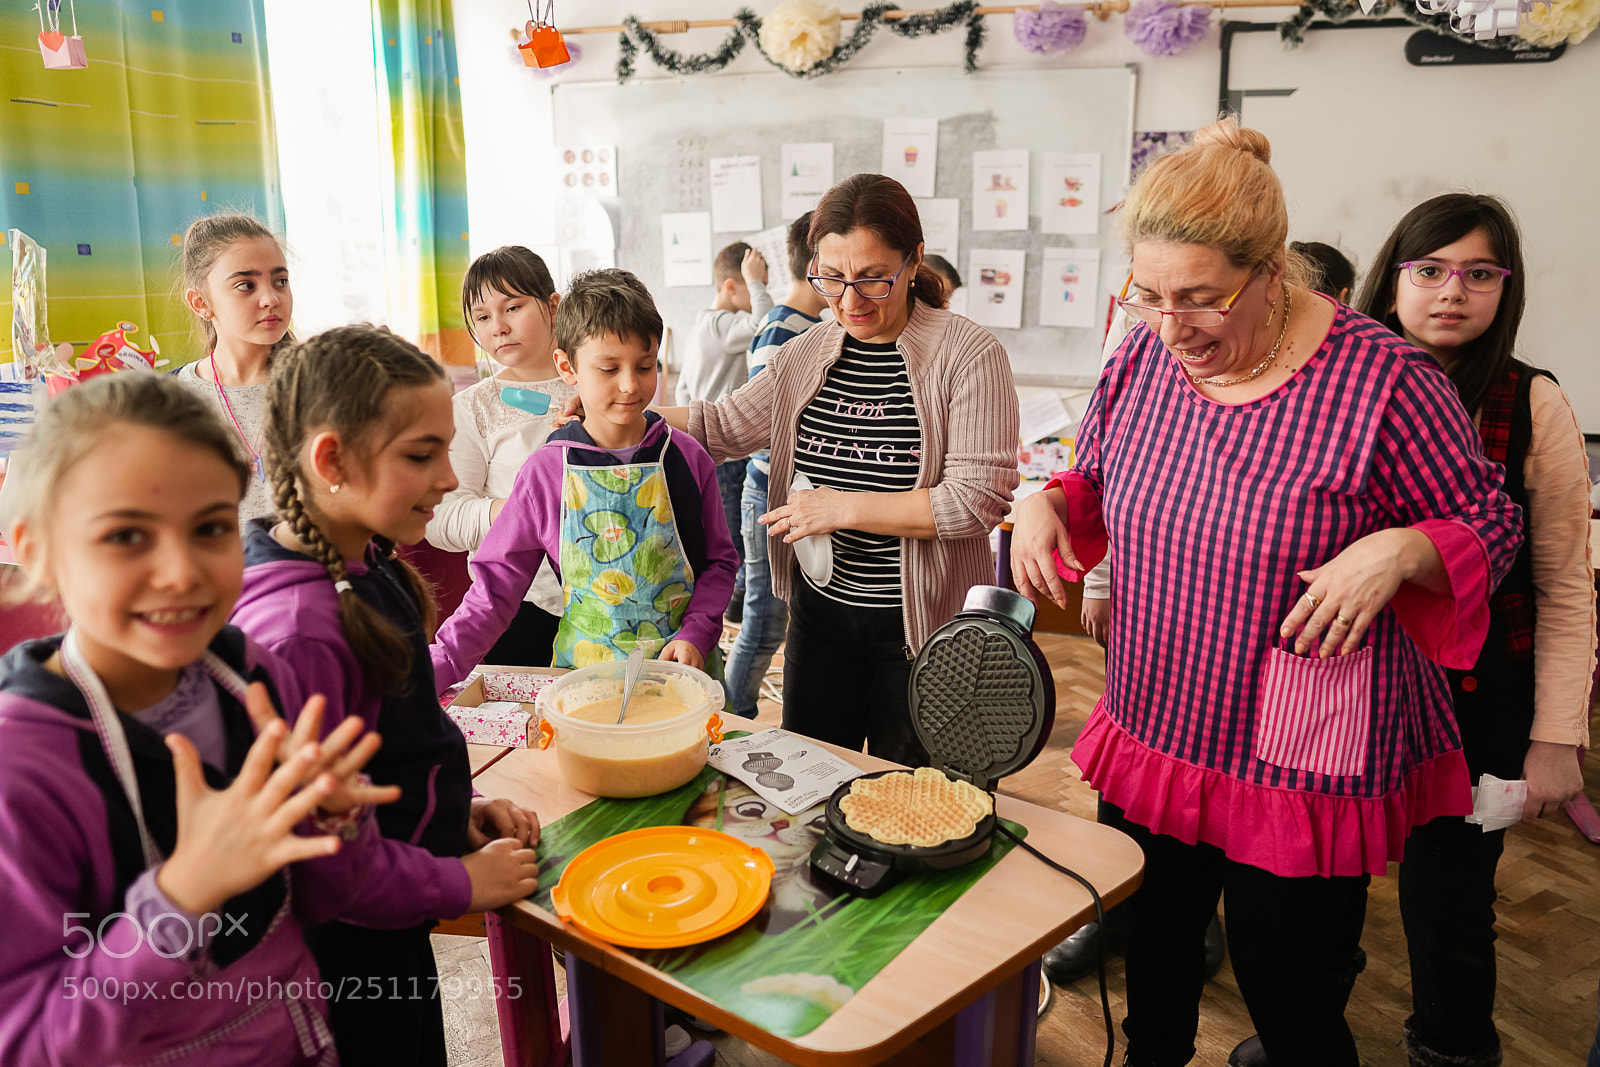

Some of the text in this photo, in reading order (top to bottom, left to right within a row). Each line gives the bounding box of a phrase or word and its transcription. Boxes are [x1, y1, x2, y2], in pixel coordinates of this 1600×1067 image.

[1514, 52, 1551, 60] HITACHI
[833, 397, 889, 419] LOOK
[799, 432, 921, 464] HINGS
